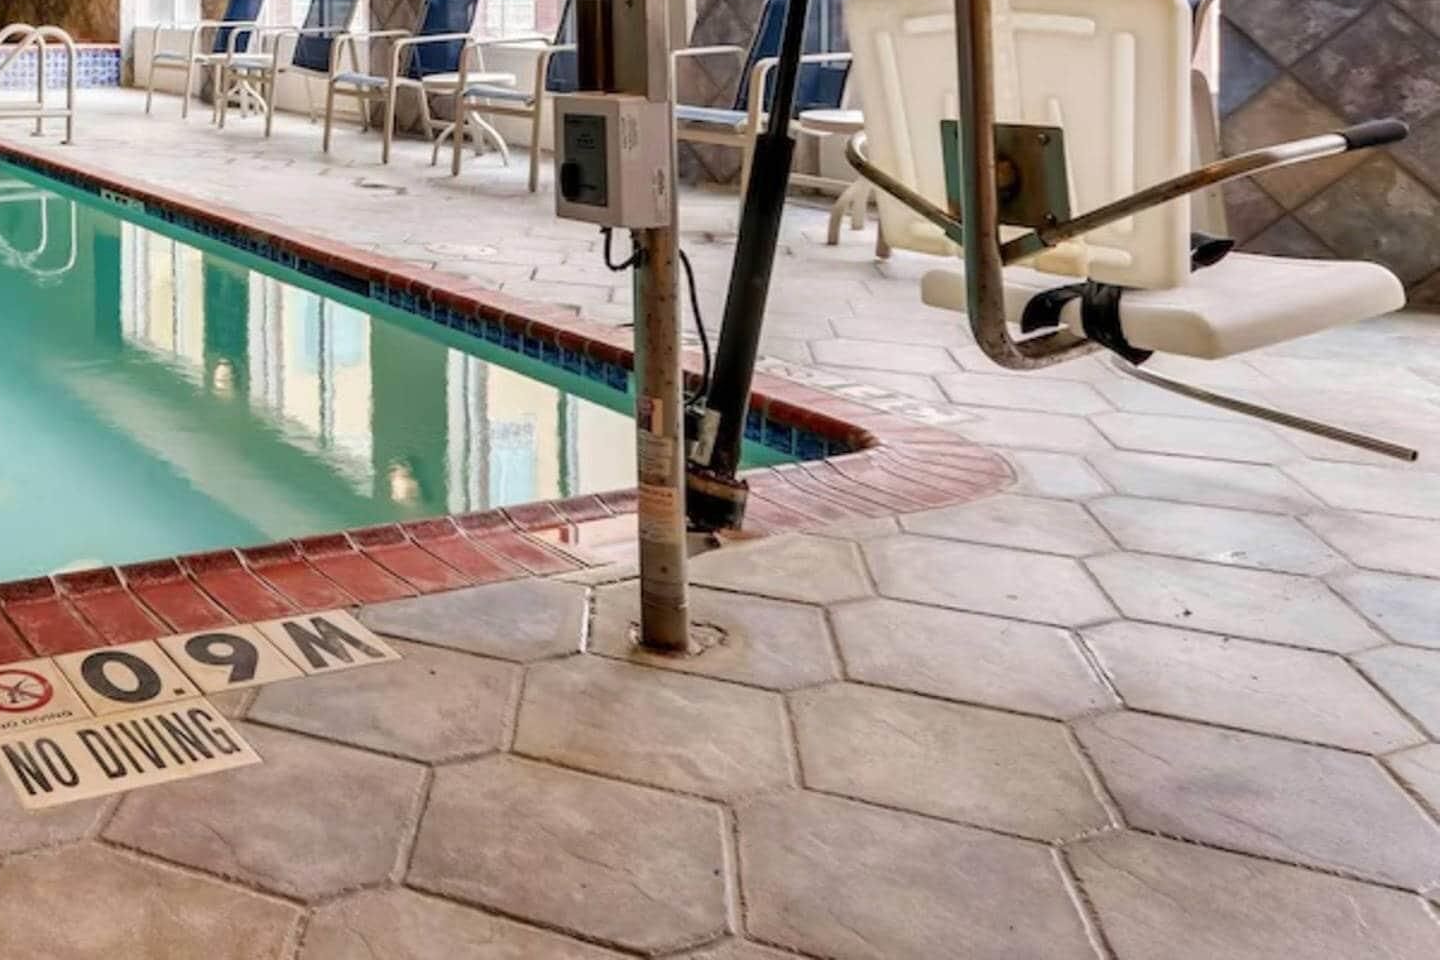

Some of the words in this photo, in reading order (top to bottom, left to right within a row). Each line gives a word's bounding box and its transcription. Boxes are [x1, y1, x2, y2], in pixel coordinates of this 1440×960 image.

[282, 616, 386, 669] M
[21, 710, 73, 726] DIVING
[1, 737, 80, 795] NO
[76, 707, 241, 780] DIVING
